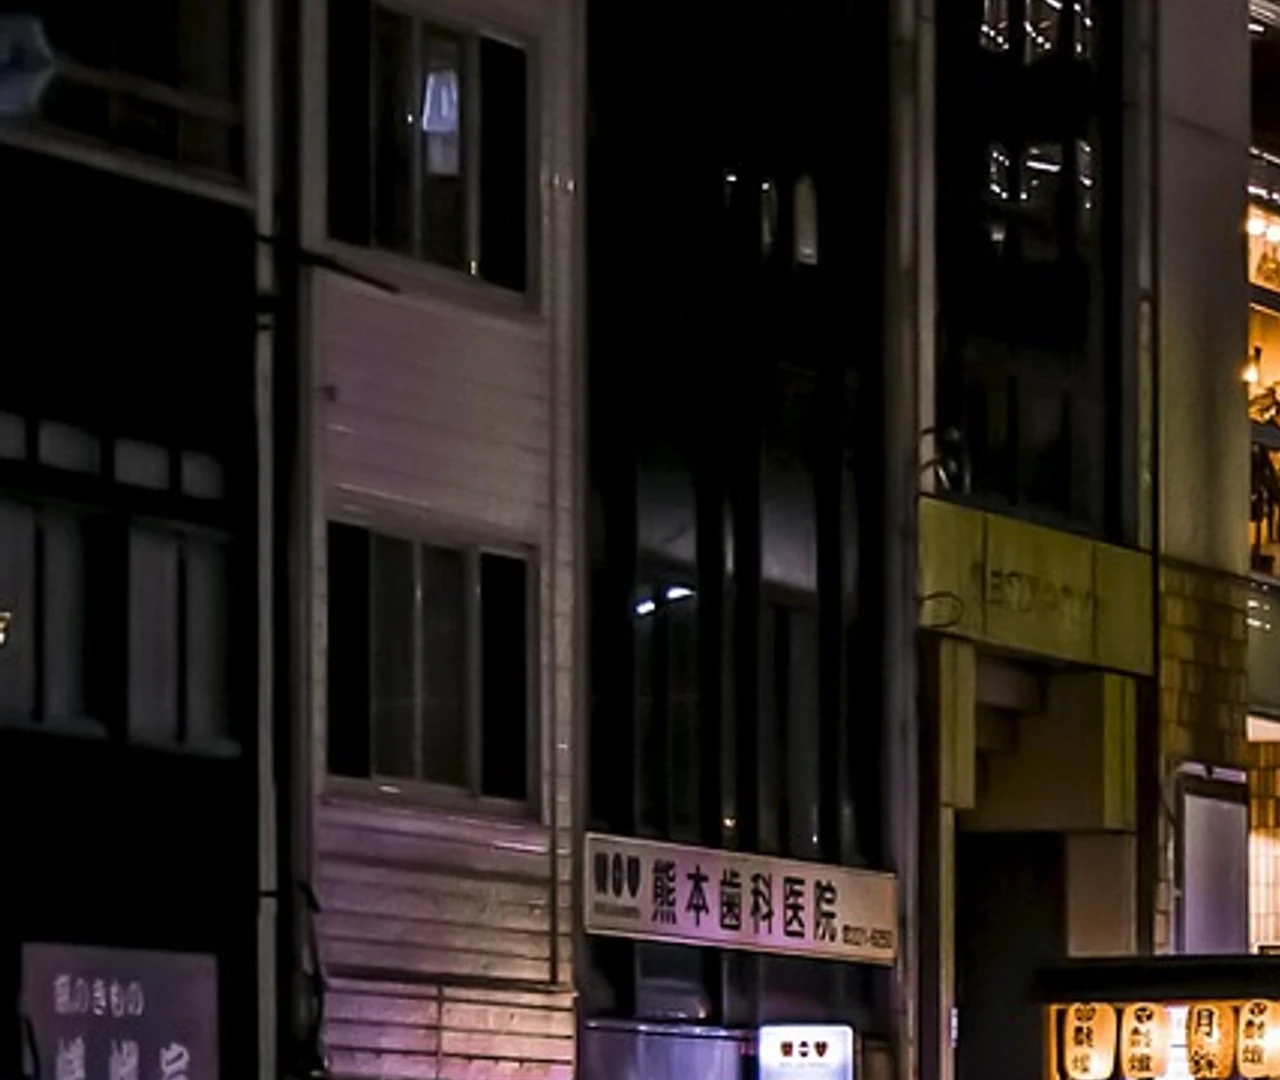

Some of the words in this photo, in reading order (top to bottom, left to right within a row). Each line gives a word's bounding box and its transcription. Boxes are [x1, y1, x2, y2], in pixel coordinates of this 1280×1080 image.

[650, 857, 838, 943] 熊本歯科医院
